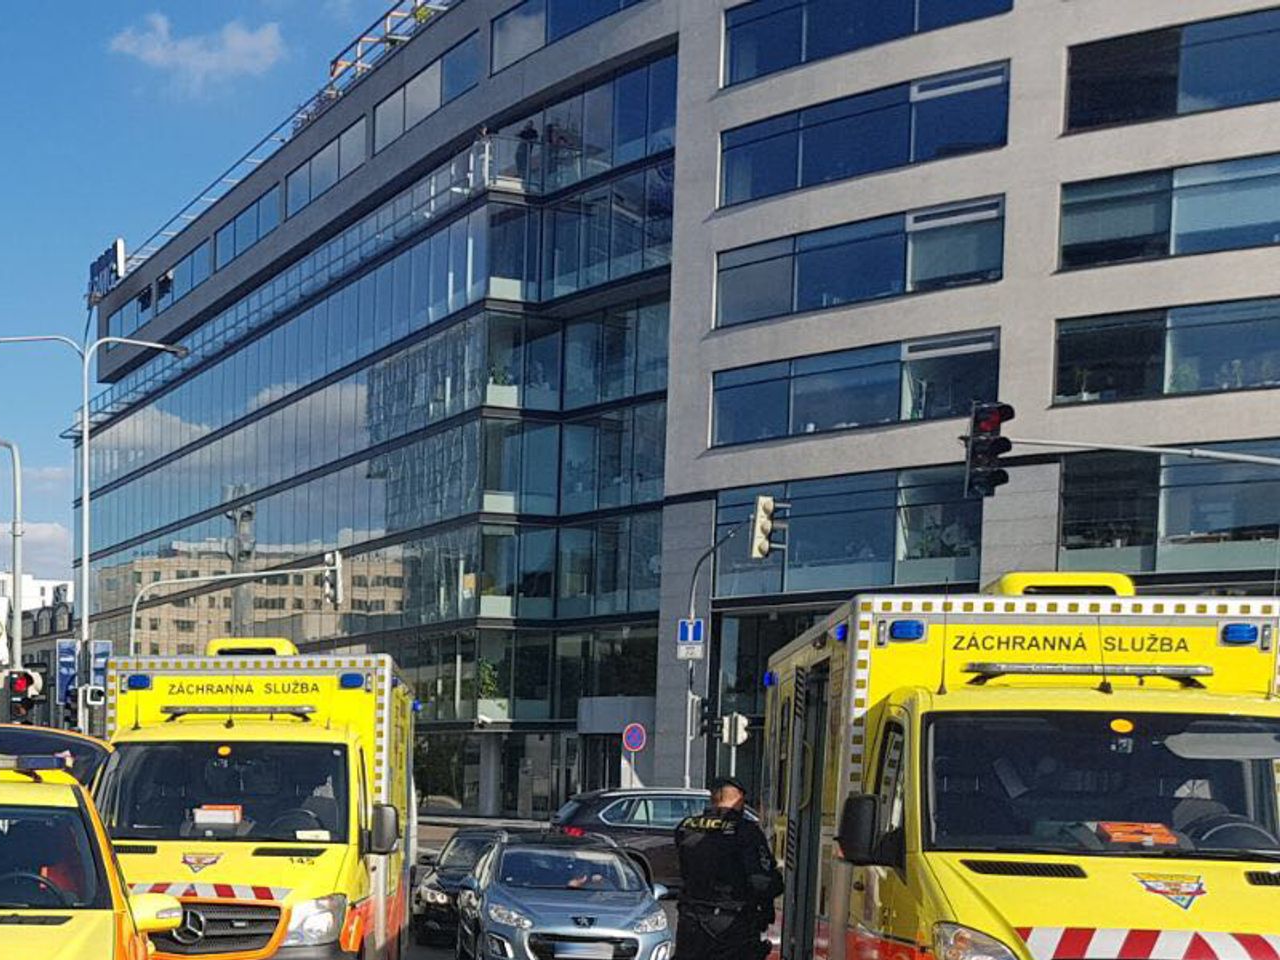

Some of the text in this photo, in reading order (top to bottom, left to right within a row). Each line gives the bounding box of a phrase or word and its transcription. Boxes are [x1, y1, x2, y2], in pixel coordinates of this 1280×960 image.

[952, 632, 1190, 652] ZÁCHRANNÁ SLUŽBA
[168, 680, 320, 695] ZÁCHRANNÁ SLUŽBA
[682, 817, 738, 830] POLICIE
